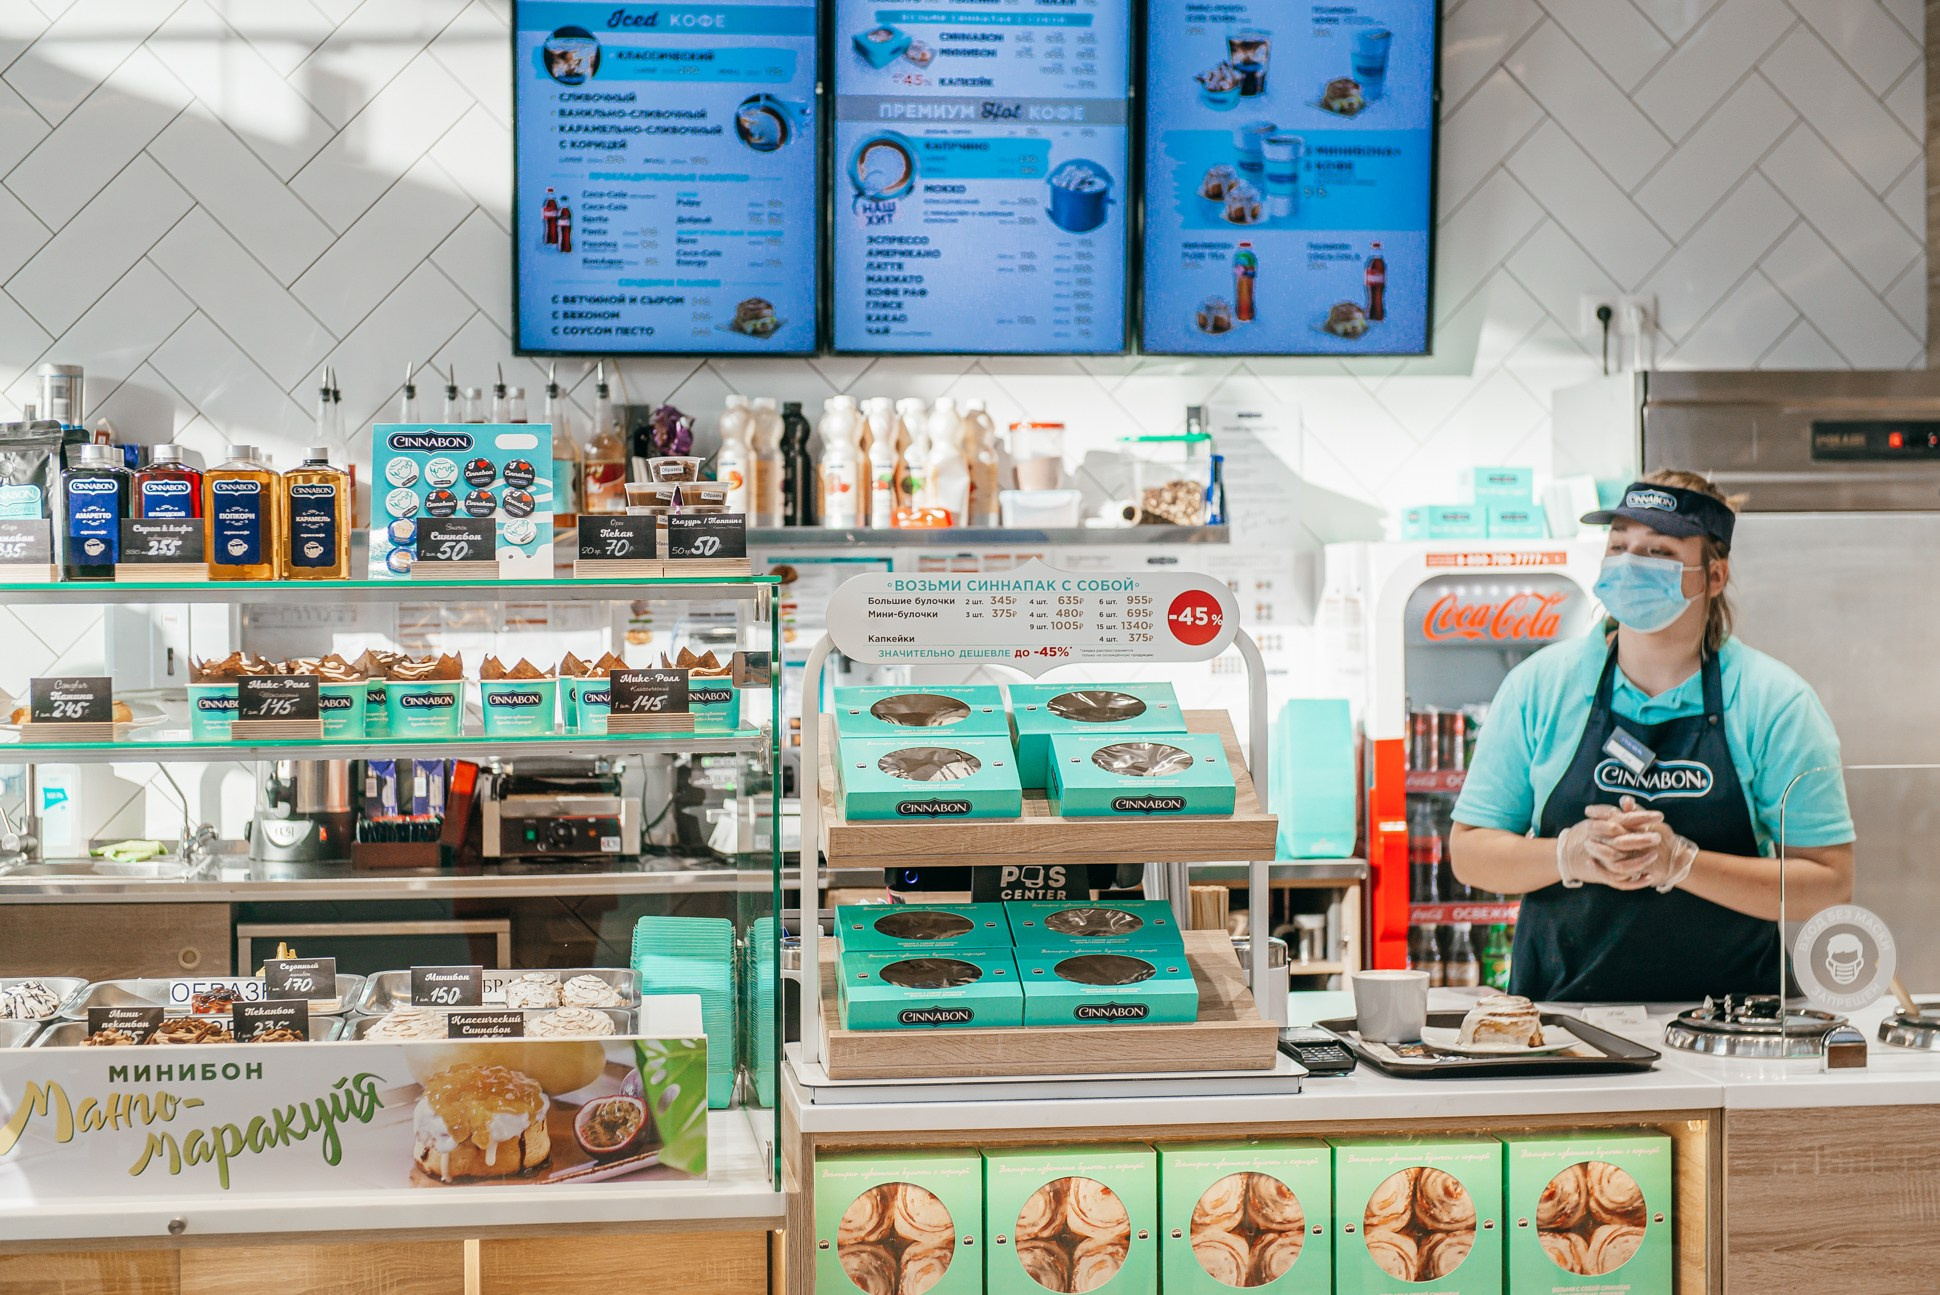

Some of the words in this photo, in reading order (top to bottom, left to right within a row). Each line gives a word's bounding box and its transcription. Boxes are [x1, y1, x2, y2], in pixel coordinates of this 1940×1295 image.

[607, 9, 658, 28] Iced
[669, 14, 725, 28] КОФЕ
[880, 104, 974, 119] ПРЕМИУМ
[1028, 106, 1084, 120] КОФЕ
[559, 140, 567, 150] С
[552, 295, 559, 305] С
[629, 295, 637, 305] И
[641, 295, 685, 305] СЫРОМ
[552, 310, 559, 320] С
[552, 326, 559, 336] С
[563, 326, 611, 336] СОУСОМ
[614, 326, 655, 336] ПЕСТО
[394, 435, 469, 448] CINNABON
[73, 481, 114, 490] CINNABON
[146, 482, 187, 492] CINNABON
[216, 481, 257, 491] CINNABON
[292, 486, 332, 496] CINNABON
[1630, 494, 1674, 507] CINNABON
[219, 512, 255, 520] ПОПКОРН
[600, 529, 634, 539] Пекан
[148, 540, 183, 556] 255
[437, 541, 469, 561] 50
[605, 539, 630, 557] 70
[672, 547, 684, 555] 50
[690, 536, 720, 556] 50
[895, 580, 961, 591] ВОЗЬМИ
[967, 580, 1056, 591] СИННАПАК
[1062, 580, 1071, 591] С
[1077, 577, 1134, 591] СОБОЙ
[868, 597, 912, 605] Большие
[915, 597, 955, 606] булочки
[868, 610, 938, 619] Мини-булочки
[1169, 607, 1223, 626] -45%
[868, 635, 915, 643] Капкейки
[878, 650, 955, 658] ЗНАЧИТЕЛЬНО
[959, 650, 1011, 659] ДЕШЕВЛЕ
[403, 696, 453, 706] CINNABON
[489, 695, 539, 705] CINNABON
[632, 695, 667, 711] 145
[52, 701, 90, 719] 245
[260, 698, 300, 715] 145
[1602, 765, 1701, 789] CINNABON
[900, 802, 968, 814] CINNABON
[1115, 799, 1182, 811] CINNABON
[1001, 889, 1067, 900] CENTER
[280, 962, 319, 971] Сезонный
[425, 973, 470, 982] Минибон
[284, 978, 314, 992] 170
[431, 987, 461, 1005] 150
[245, 1007, 295, 1017] Пеканбон
[902, 1010, 970, 1022] CINNABON
[1078, 1006, 1145, 1018] CINNABON
[452, 1014, 522, 1025] Классический
[462, 1024, 511, 1034] Синнабон
[109, 1062, 263, 1082] МИНИБОН
[0, 1080, 204, 1156] Манго-
[129, 1073, 387, 1189] маракуйя
